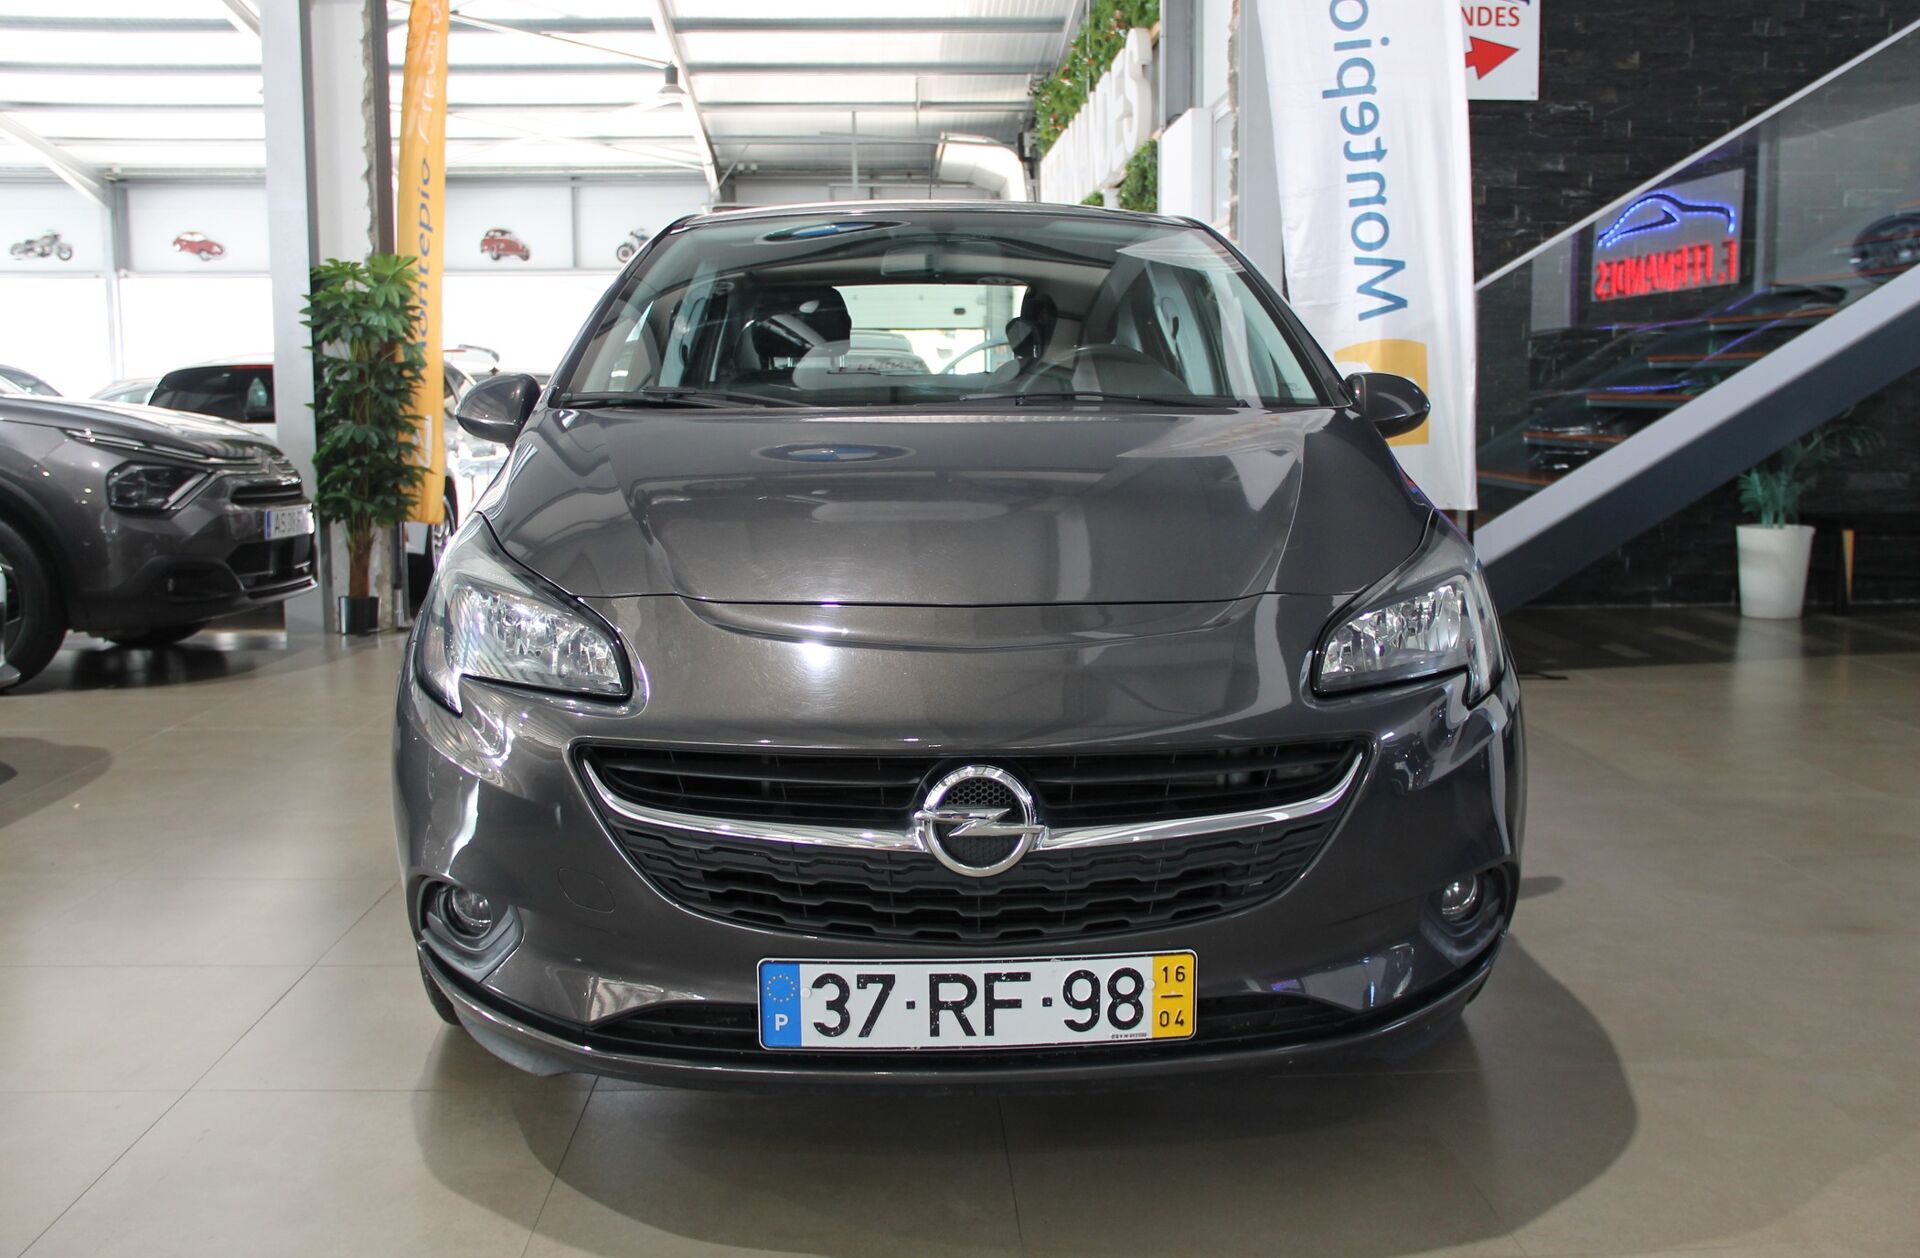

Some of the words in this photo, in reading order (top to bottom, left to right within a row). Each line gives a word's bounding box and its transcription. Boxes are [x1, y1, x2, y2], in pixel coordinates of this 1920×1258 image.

[1162, 965, 1186, 984] 16
[774, 1013, 788, 1032] P
[1159, 1009, 1185, 1028] 04
